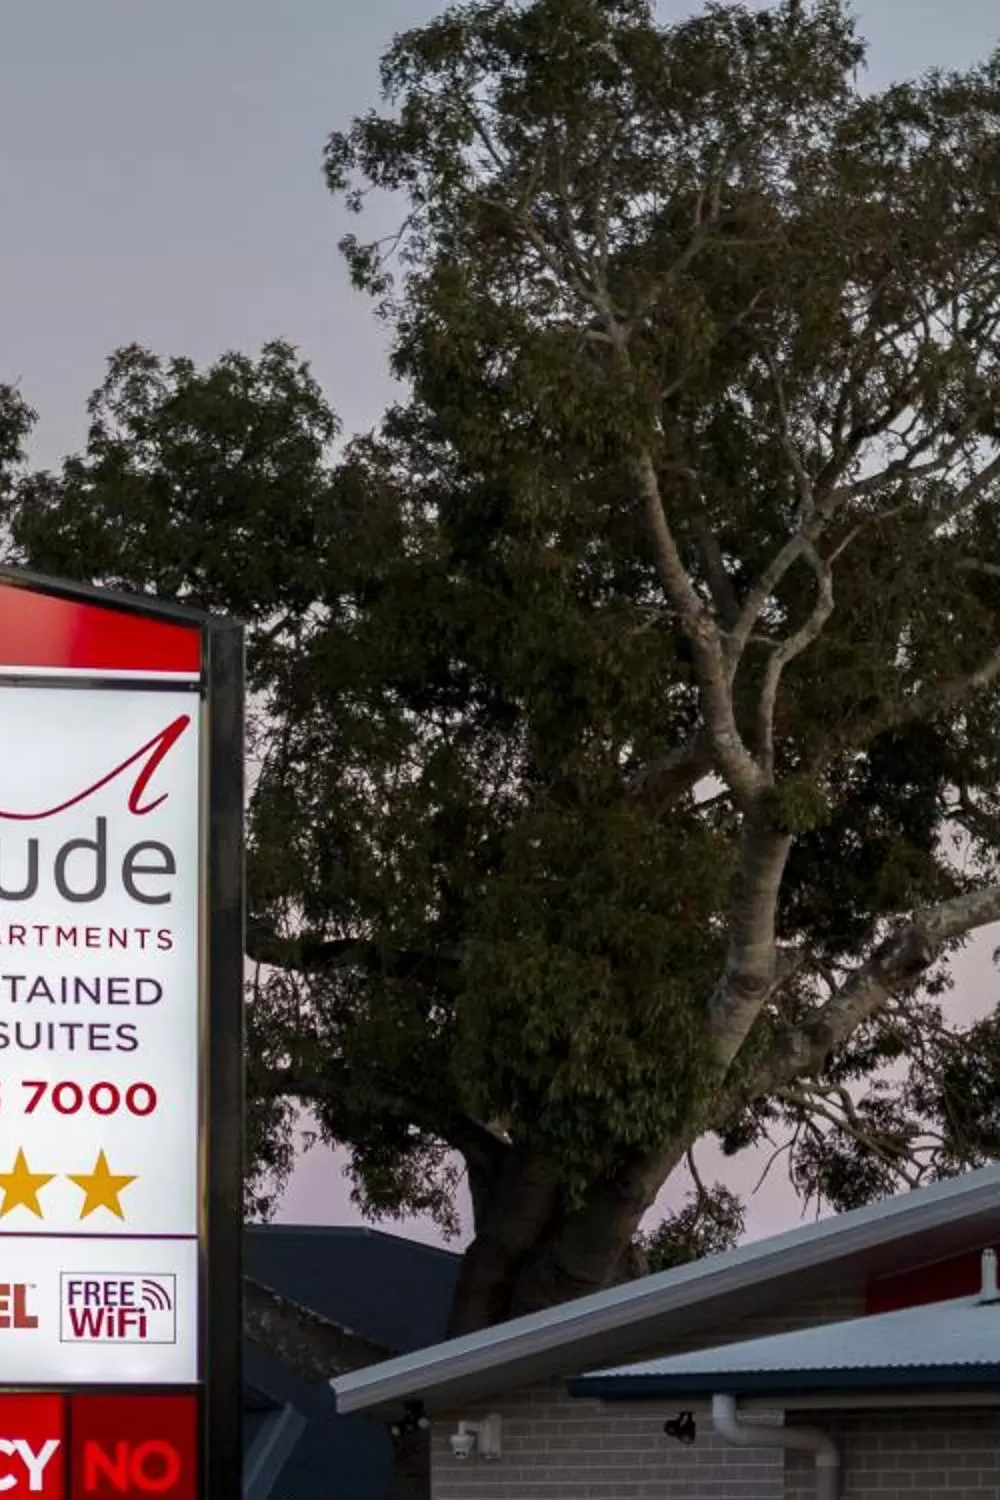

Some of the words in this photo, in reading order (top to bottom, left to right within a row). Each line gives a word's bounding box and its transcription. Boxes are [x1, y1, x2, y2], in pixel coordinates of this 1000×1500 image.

[21, 1080, 158, 1117] 7000
[68, 1280, 135, 1307] FREE
[69, 1307, 148, 1339] WiFi
[83, 1440, 181, 1492] NO
